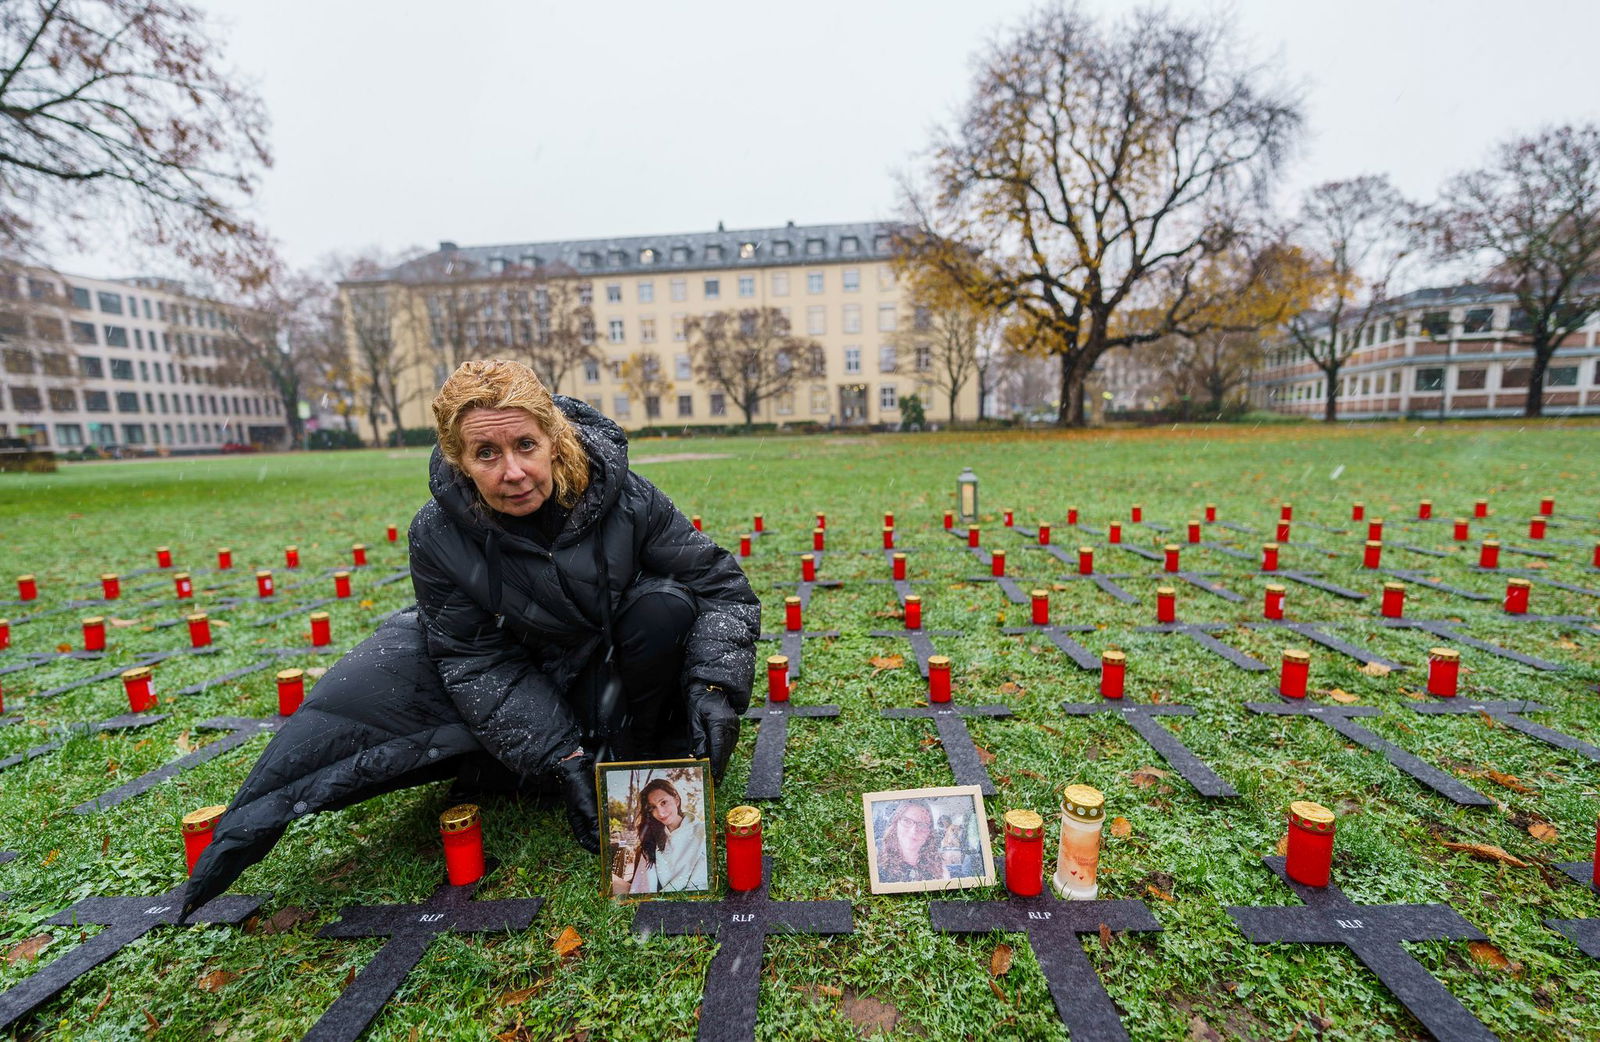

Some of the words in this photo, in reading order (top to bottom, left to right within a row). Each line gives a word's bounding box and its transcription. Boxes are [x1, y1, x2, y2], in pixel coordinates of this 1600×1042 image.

[419, 914, 445, 922] RLP
[732, 914, 755, 922] RLP
[1028, 911, 1052, 920] RLP
[1336, 919, 1365, 929] RLP
